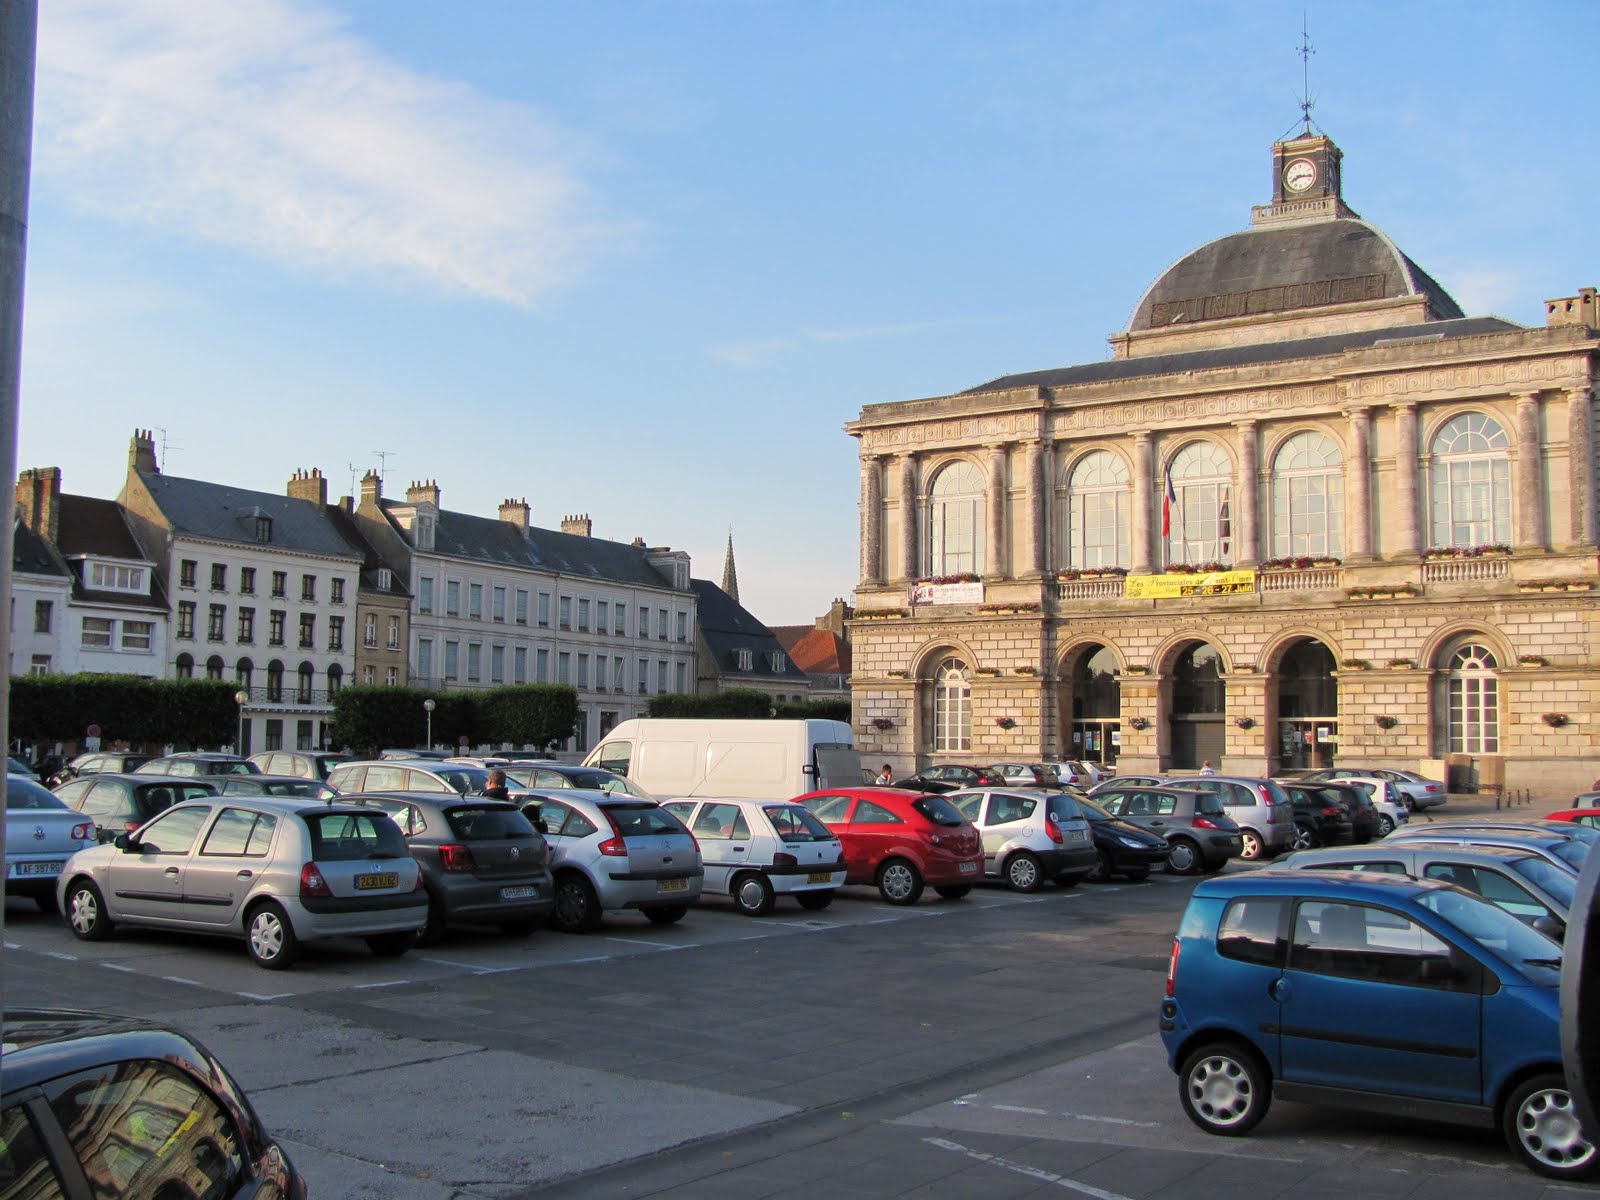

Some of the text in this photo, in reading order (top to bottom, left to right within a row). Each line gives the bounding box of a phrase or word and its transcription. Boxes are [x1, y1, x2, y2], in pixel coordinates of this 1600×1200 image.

[1152, 274, 1385, 326] SAINT OMER
[1129, 578, 1144, 588] Les
[1149, 575, 1193, 587] Provinciales
[1182, 586, 1194, 596] 25
[1202, 585, 1214, 595] 26
[1221, 584, 1233, 594] 27
[1234, 583, 1253, 593] Juin
